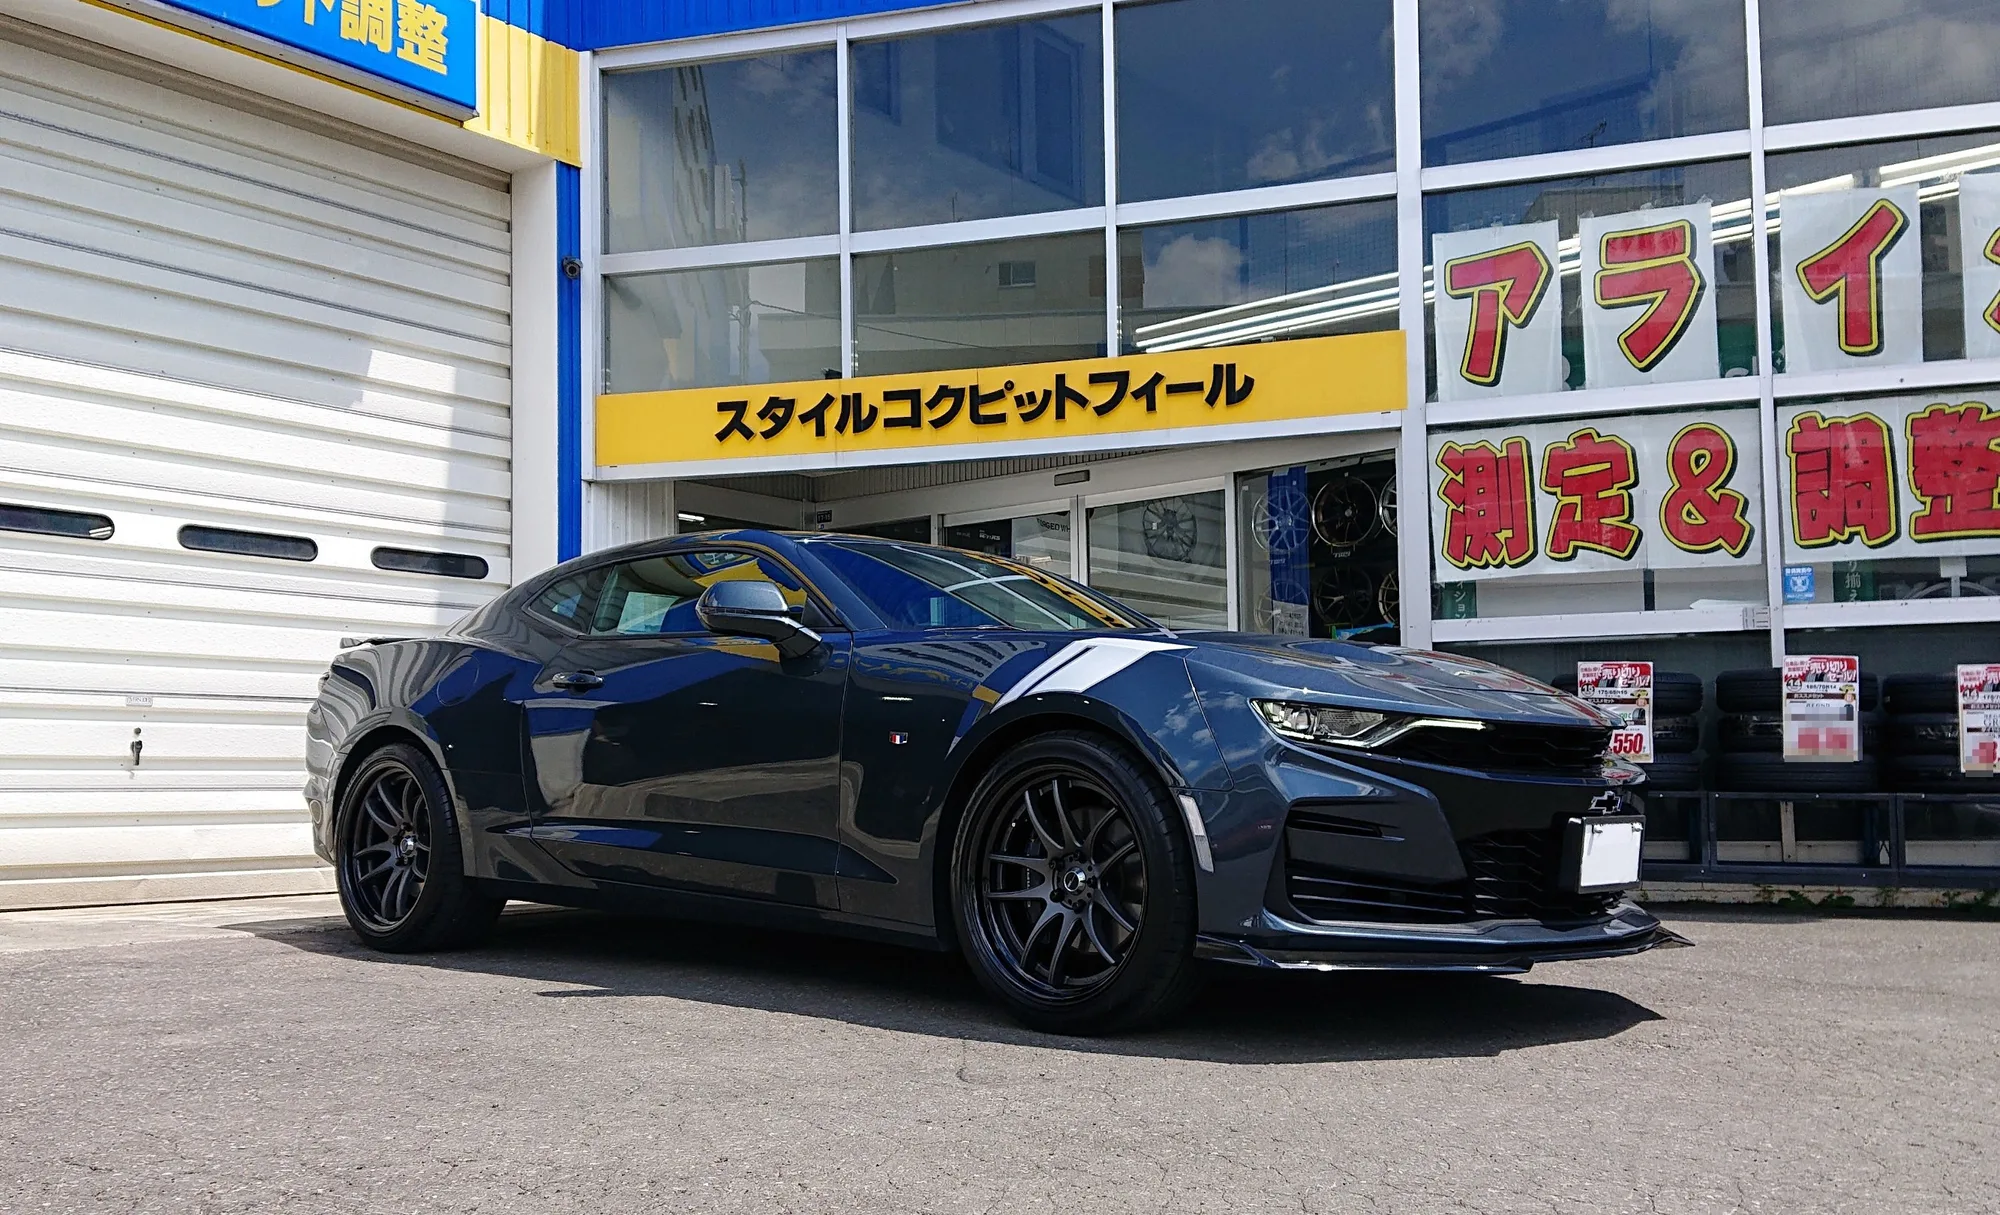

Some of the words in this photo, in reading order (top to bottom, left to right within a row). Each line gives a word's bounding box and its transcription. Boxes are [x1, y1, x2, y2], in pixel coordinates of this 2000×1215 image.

[1444, 197, 2000, 387] アライ
[714, 362, 1255, 443] スタイルコクピットフィール
